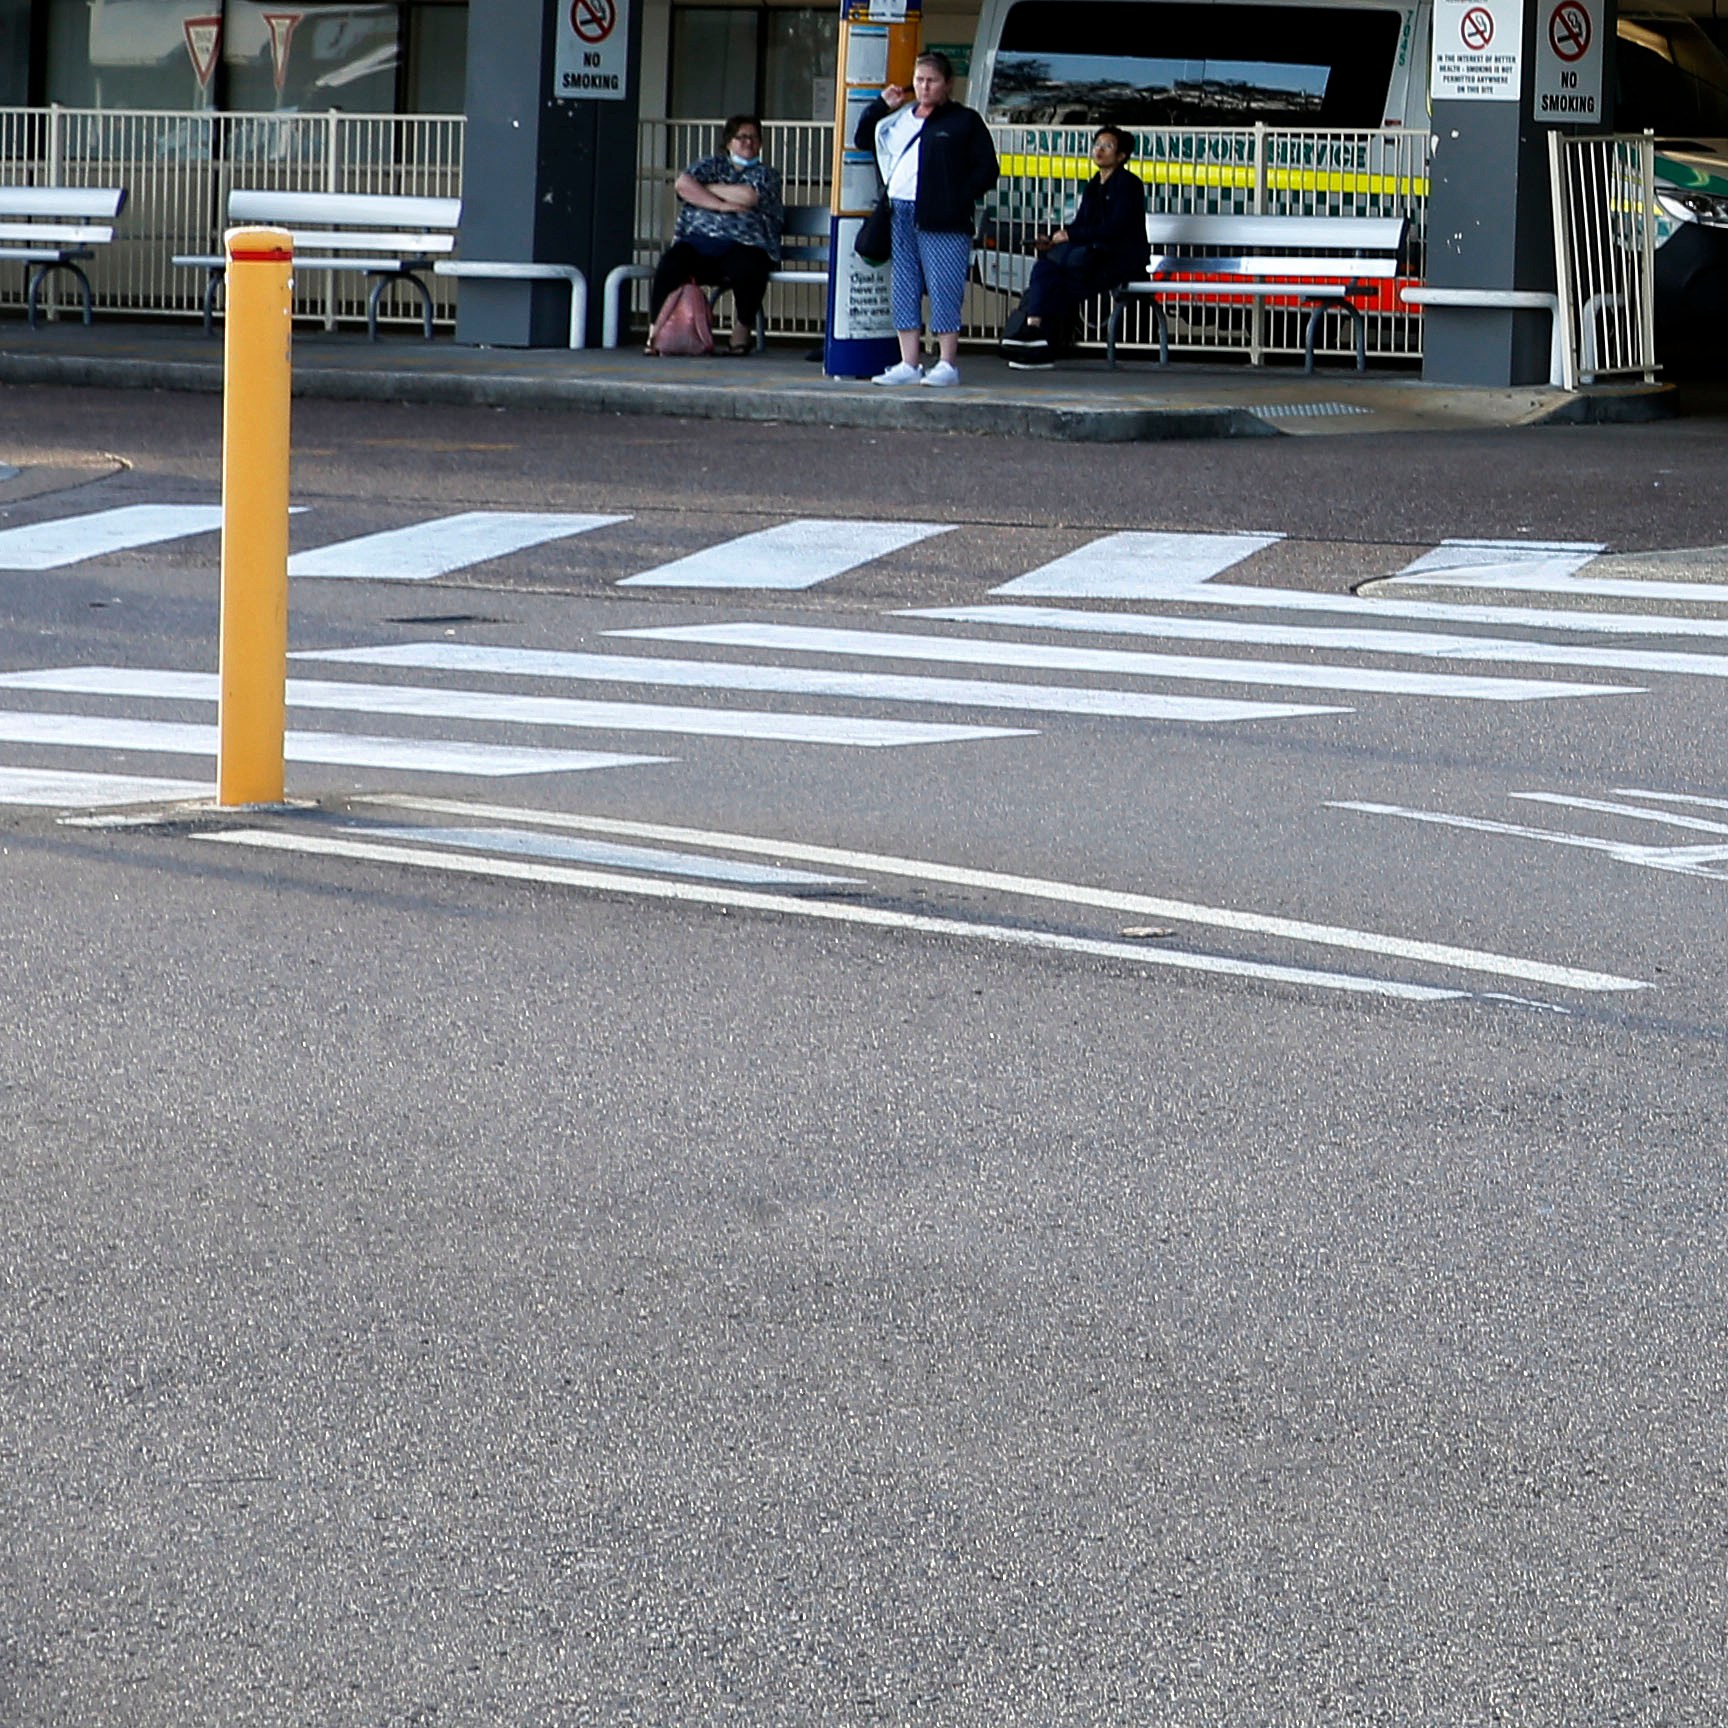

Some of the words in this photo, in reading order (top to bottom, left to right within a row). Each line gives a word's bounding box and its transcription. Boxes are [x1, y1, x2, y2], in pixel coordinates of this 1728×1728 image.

[1399, 9, 1415, 67] 7045
[583, 52, 600, 68] NO
[1445, 55, 1455, 63] THE
[1457, 55, 1484, 63] INTEREST
[1466, 65, 1492, 73] SMOKING
[562, 72, 619, 90] SMOKING
[1443, 75, 1475, 84] PERMITTED
[1477, 76, 1509, 84] ANYWHERE
[1561, 71, 1577, 88] NO
[1541, 94, 1595, 114] SMOKING
[1267, 139, 1366, 169] SERVICE
